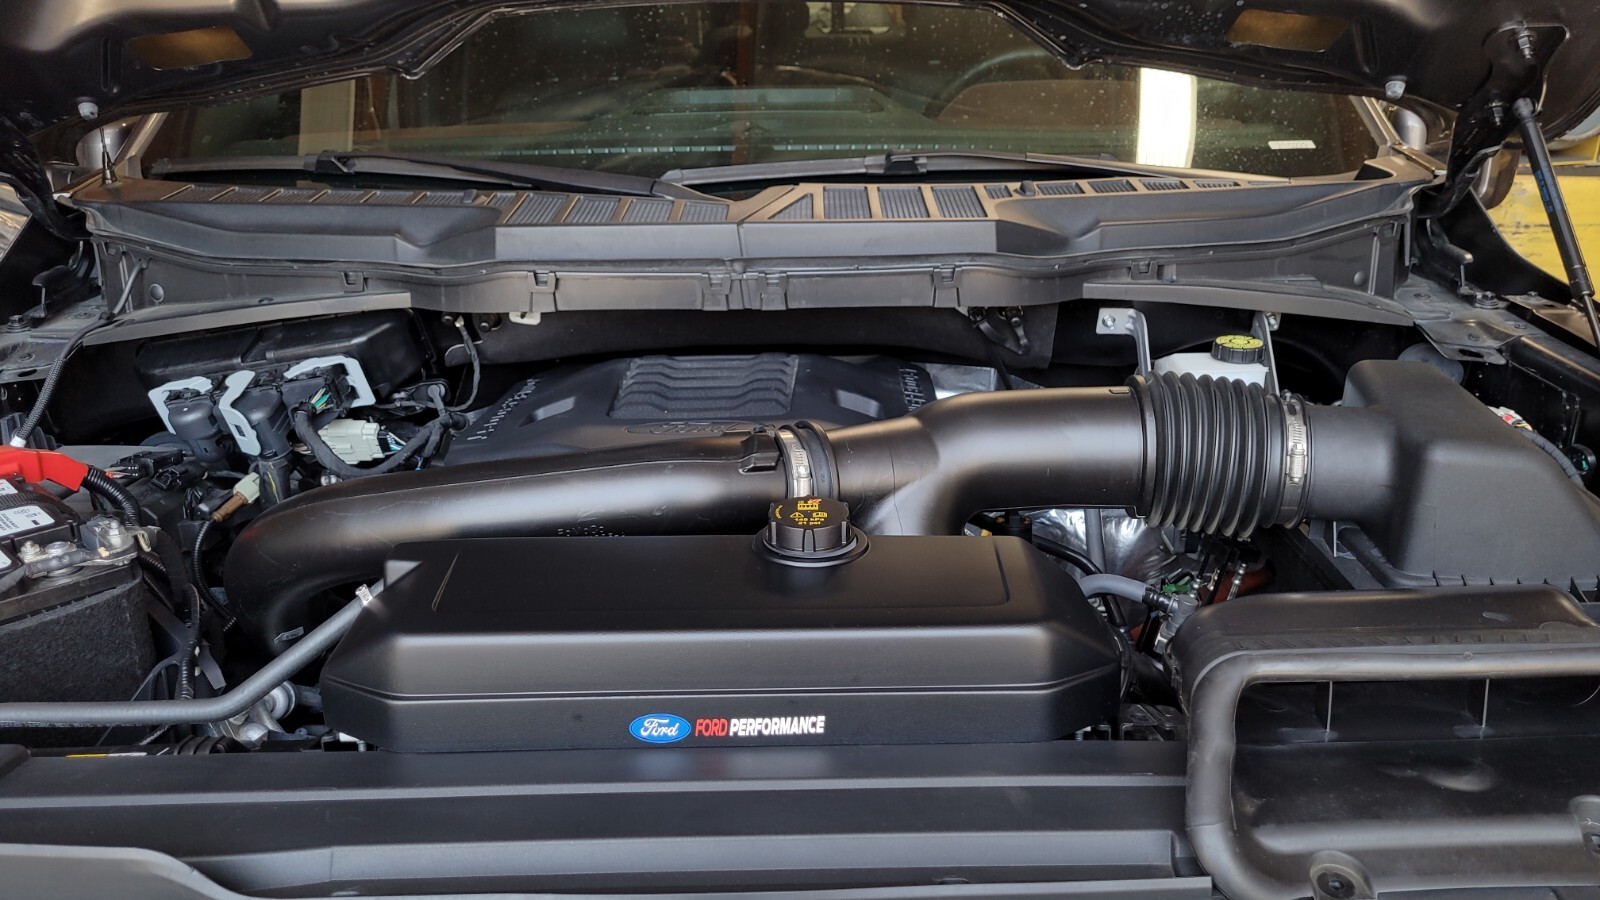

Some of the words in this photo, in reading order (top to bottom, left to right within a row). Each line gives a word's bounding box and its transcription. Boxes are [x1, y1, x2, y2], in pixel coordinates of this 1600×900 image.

[640, 718, 679, 737] Ford
[695, 718, 728, 737] FORD
[729, 715, 826, 737] PERFORMANCE
